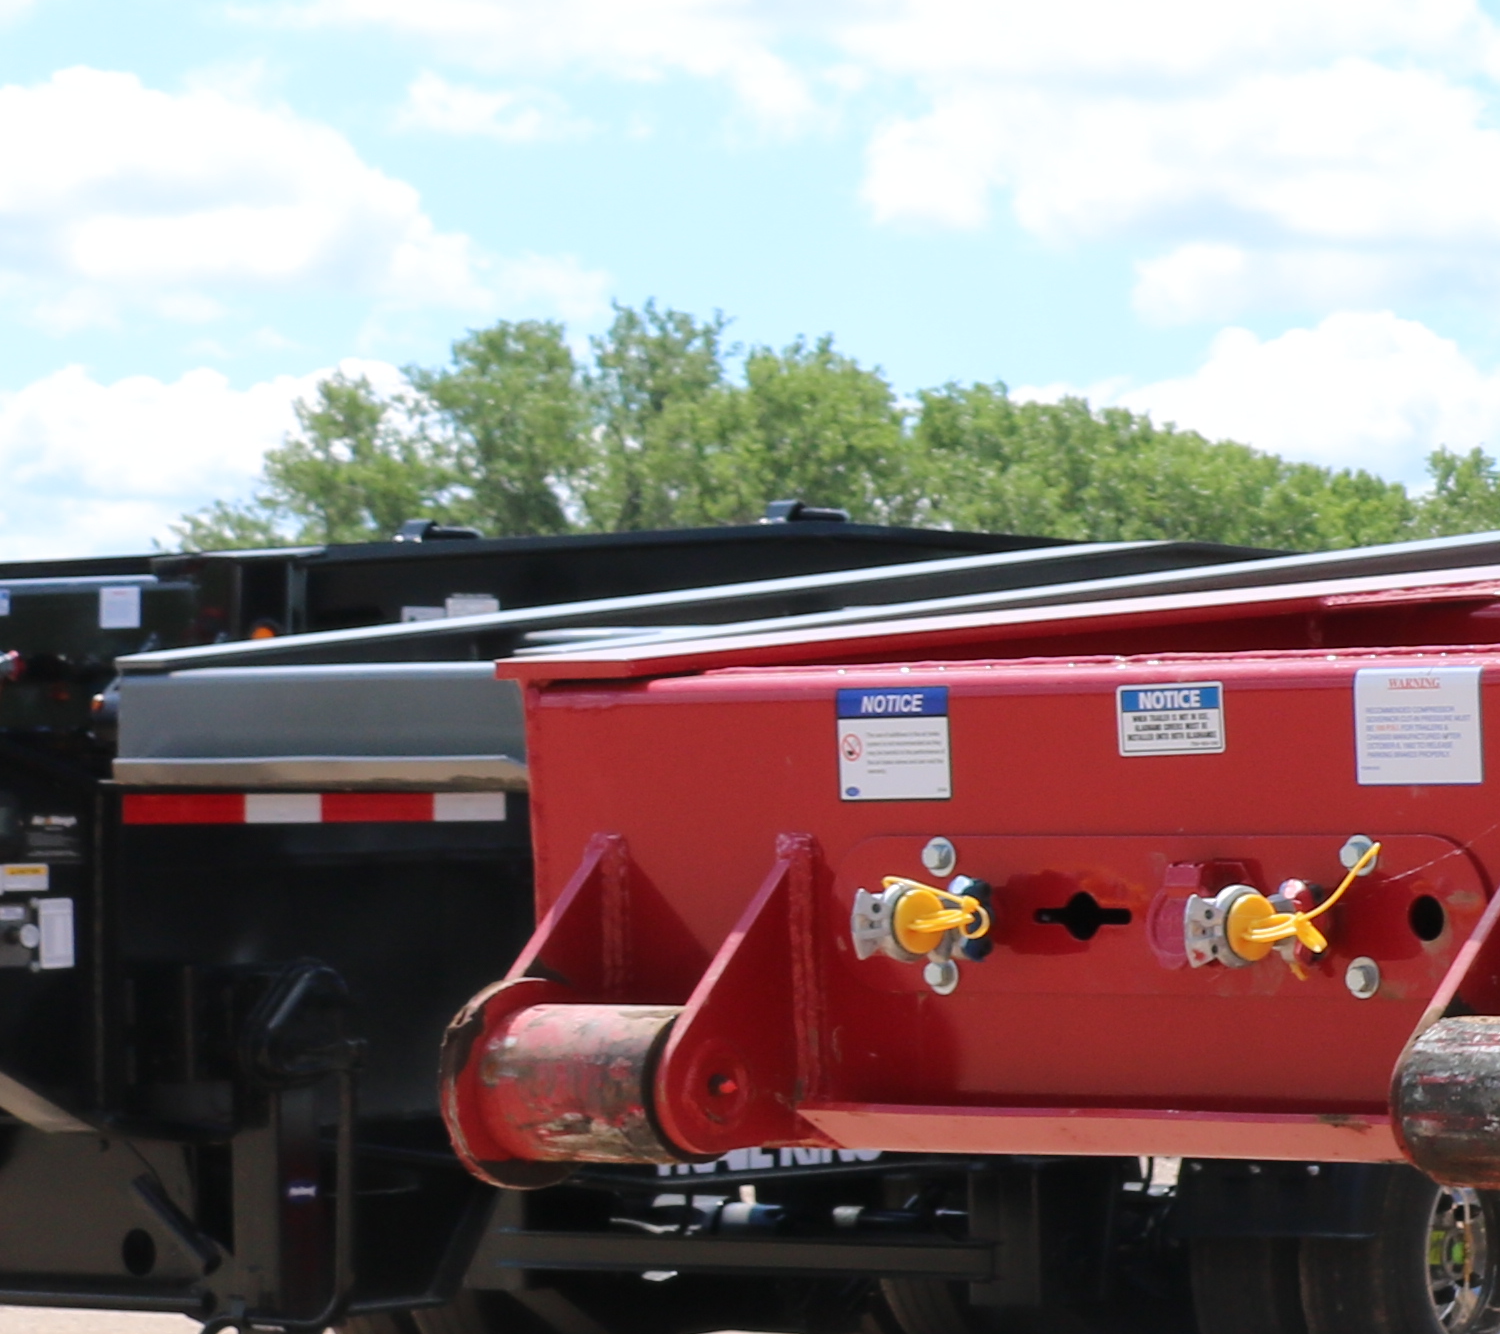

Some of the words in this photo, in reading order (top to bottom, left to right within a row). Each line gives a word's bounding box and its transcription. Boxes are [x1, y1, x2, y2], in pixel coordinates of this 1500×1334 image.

[1387, 677, 1441, 689] WARNING
[861, 693, 924, 714] NOTICE
[1138, 689, 1201, 709] NOTICE
